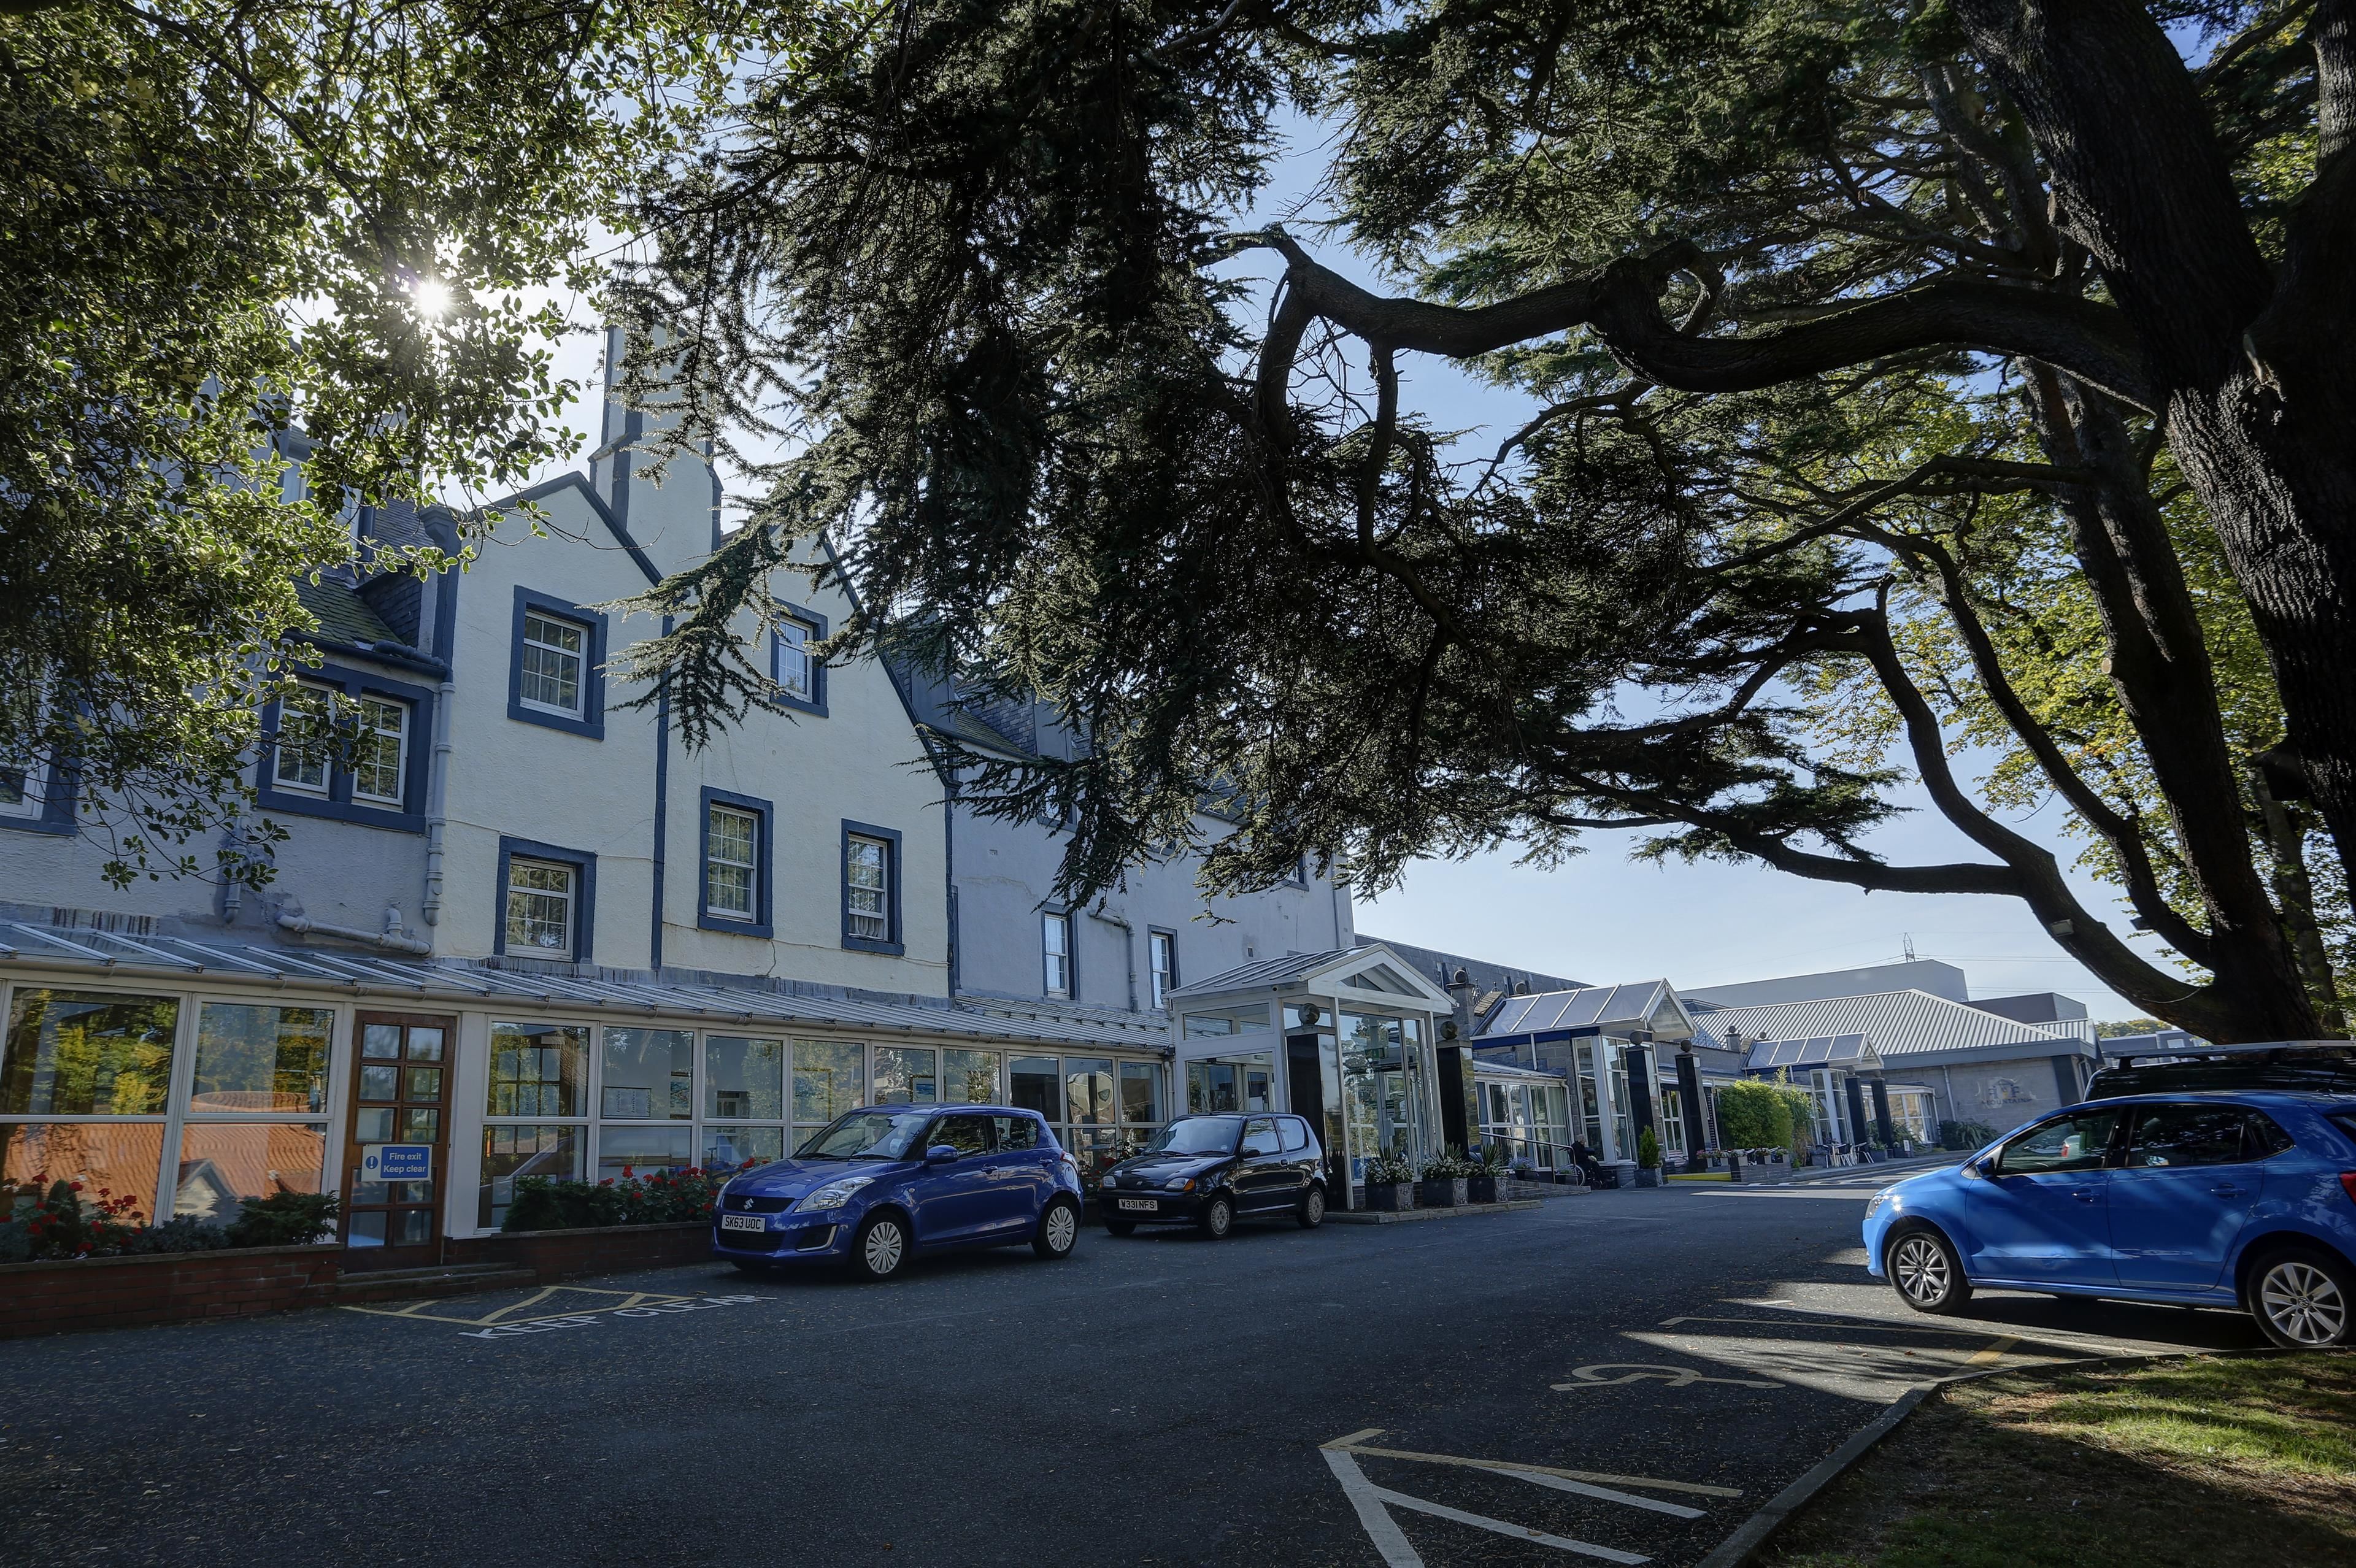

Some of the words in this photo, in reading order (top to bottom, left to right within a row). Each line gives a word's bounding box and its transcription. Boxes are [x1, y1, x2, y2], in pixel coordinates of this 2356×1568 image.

[383, 1165, 404, 1174] Keep
[725, 1216, 744, 1228] SK63
[458, 1315, 602, 1339] KEEP
[613, 1294, 777, 1318] CLEAR
